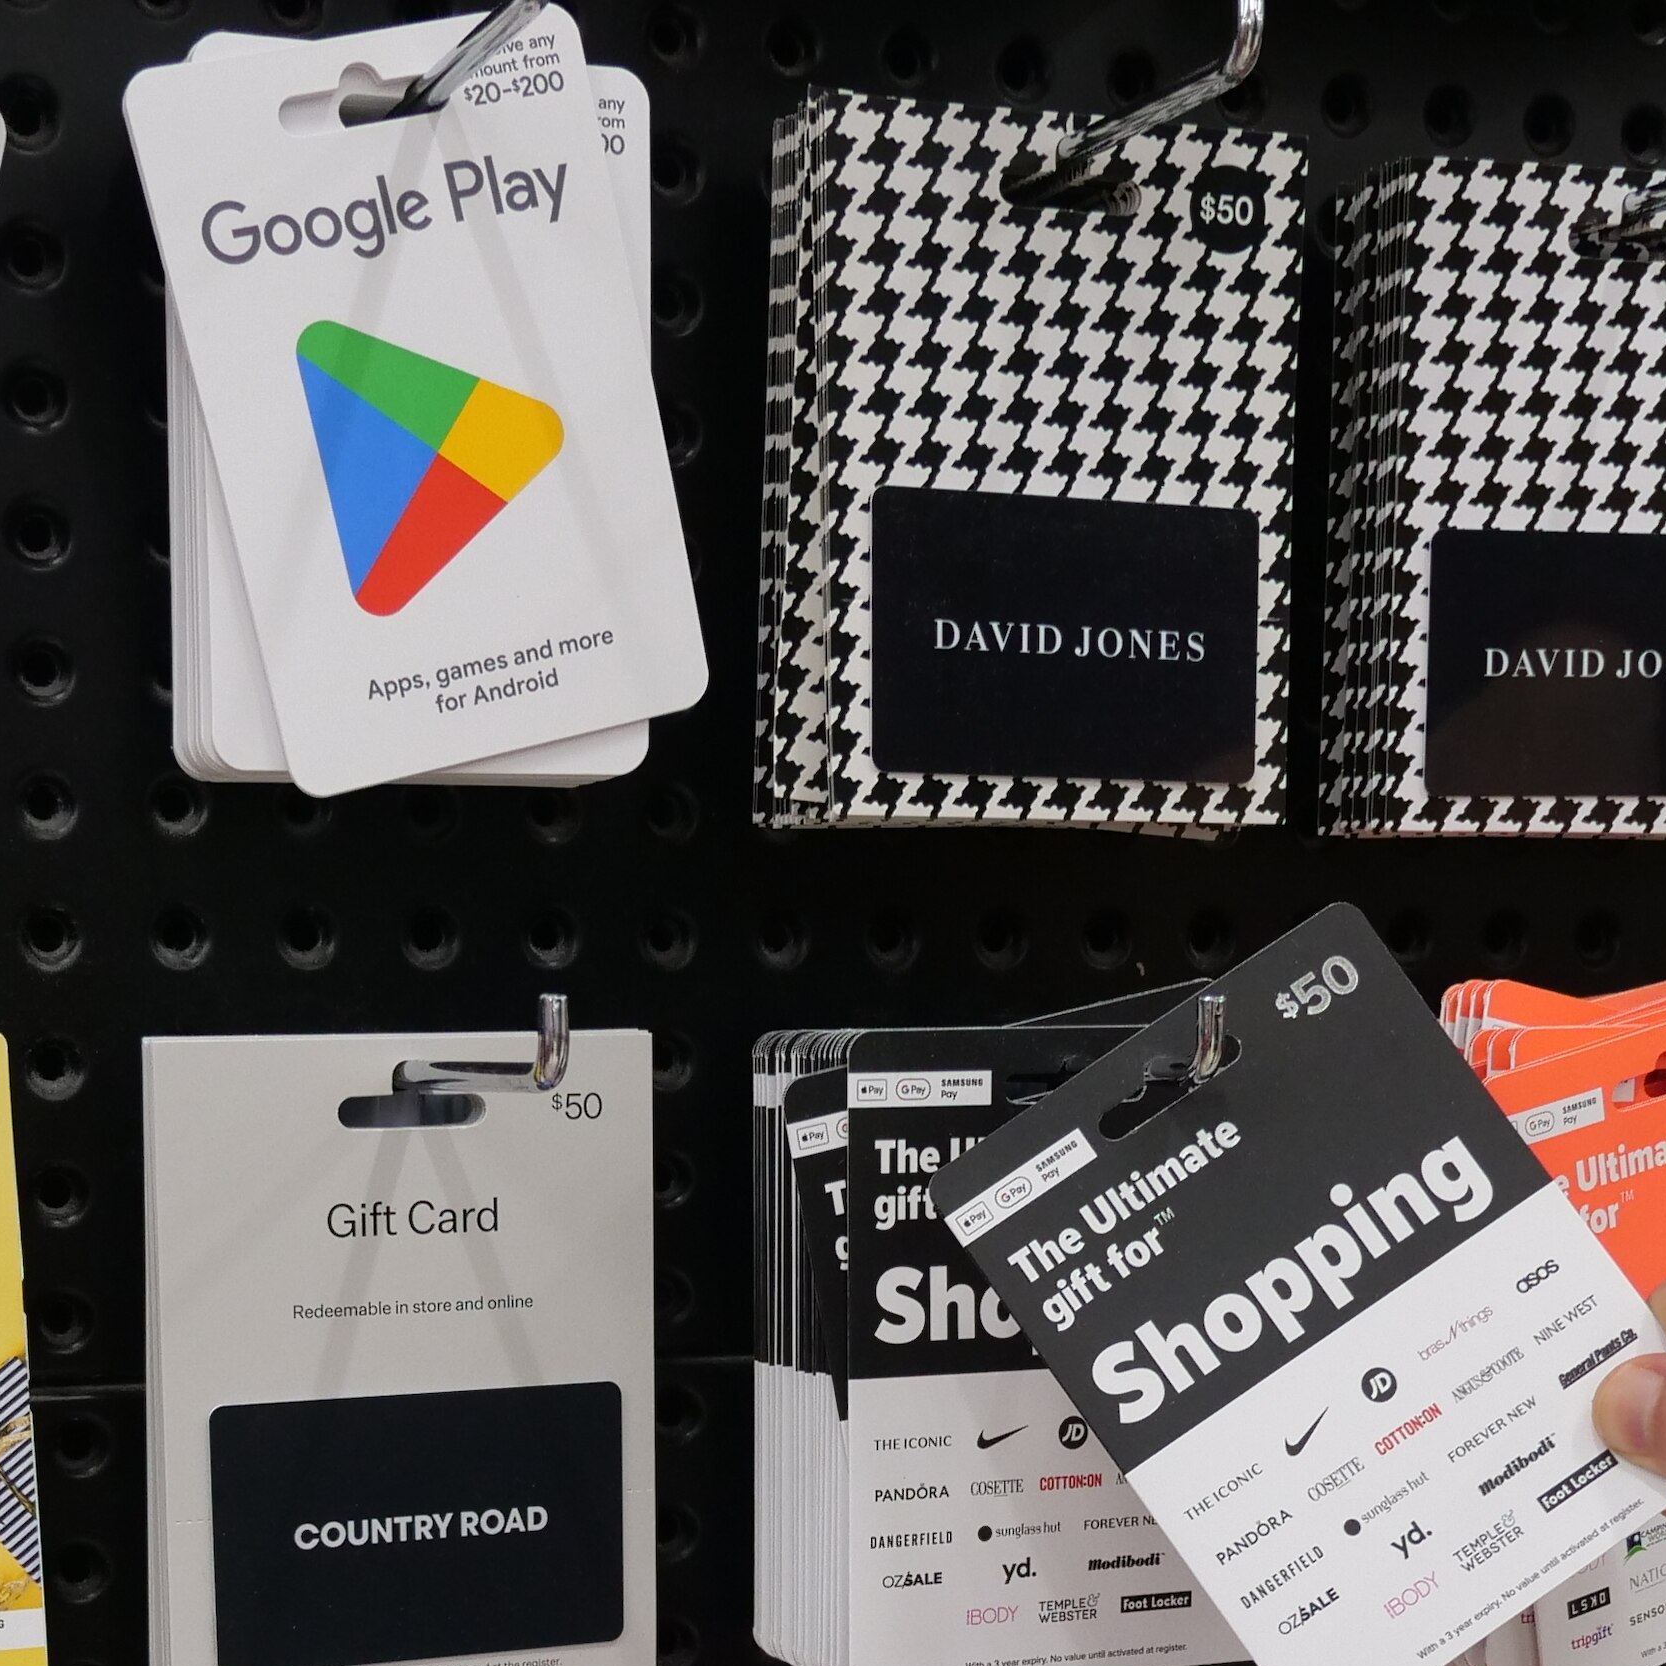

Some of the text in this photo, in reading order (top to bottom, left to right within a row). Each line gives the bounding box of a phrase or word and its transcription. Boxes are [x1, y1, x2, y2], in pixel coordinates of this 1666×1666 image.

[201, 156, 568, 265] Google Play
[1199, 193, 1254, 226] $50
[933, 618, 1206, 663] DAVID JONES
[1484, 649, 1606, 680] DAVID
[1275, 956, 1359, 1019] $50
[551, 1093, 602, 1120] $50
[327, 1198, 499, 1238] Gift Card
[1007, 1119, 1241, 1284] The Ultimate
[1091, 1135, 1493, 1423] Shopping
[1516, 1259, 1559, 1294] asos
[292, 1293, 534, 1320] Redeemable in store and online
[1374, 1404, 1442, 1456] COTTON:ON
[1040, 1473, 1102, 1491] COTTON:ON
[1183, 1464, 1263, 1521] THE ICONIC
[294, 1507, 548, 1550] COUNTRY ROAD
[870, 1530, 953, 1549] DANGERFIELD
[1002, 1558, 1037, 1584] yd.
[1122, 1595, 1190, 1611] Foot Locker
